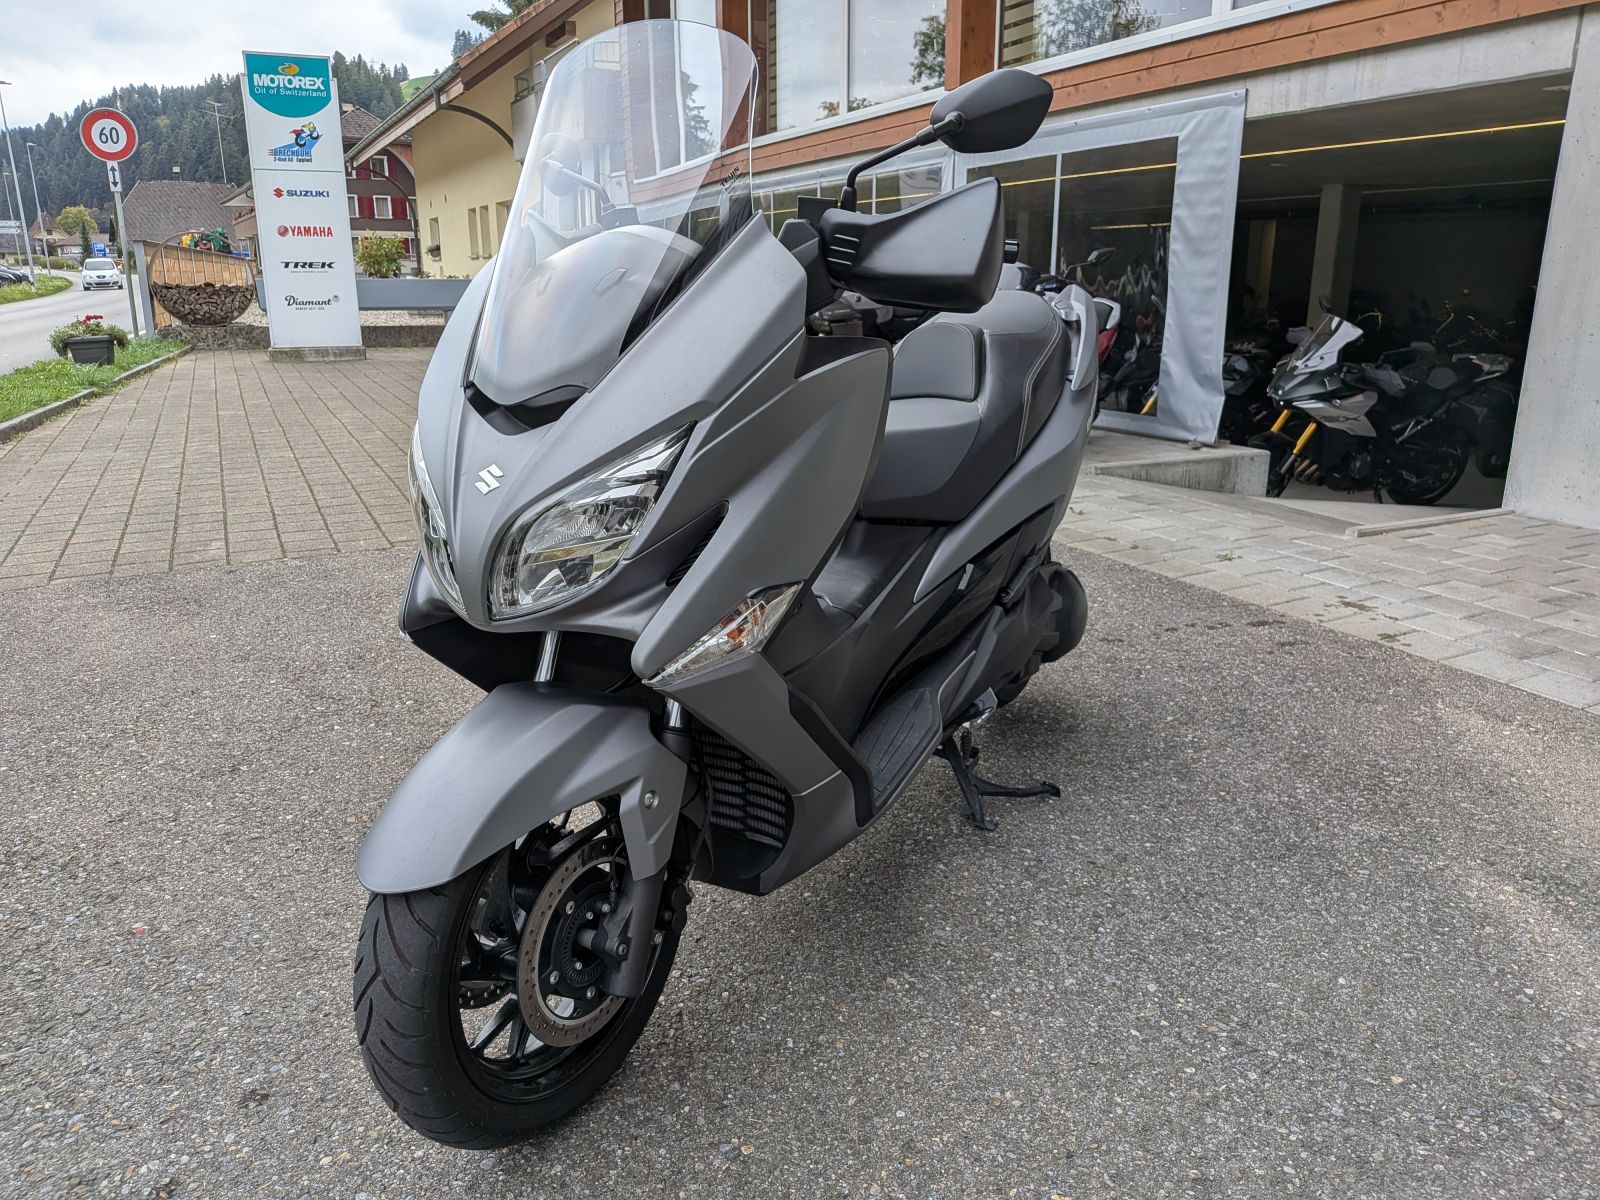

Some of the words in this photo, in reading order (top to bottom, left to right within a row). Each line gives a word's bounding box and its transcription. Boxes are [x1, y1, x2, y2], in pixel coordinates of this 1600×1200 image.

[253, 74, 324, 90] MOTOREX
[269, 87, 277, 95] of
[279, 88, 327, 97] Switzerland
[99, 127, 119, 144] 60
[286, 189, 329, 198] SUZUKI
[289, 225, 333, 237] YAMAHA
[280, 261, 336, 269] TREK
[284, 295, 332, 307] Diamant
